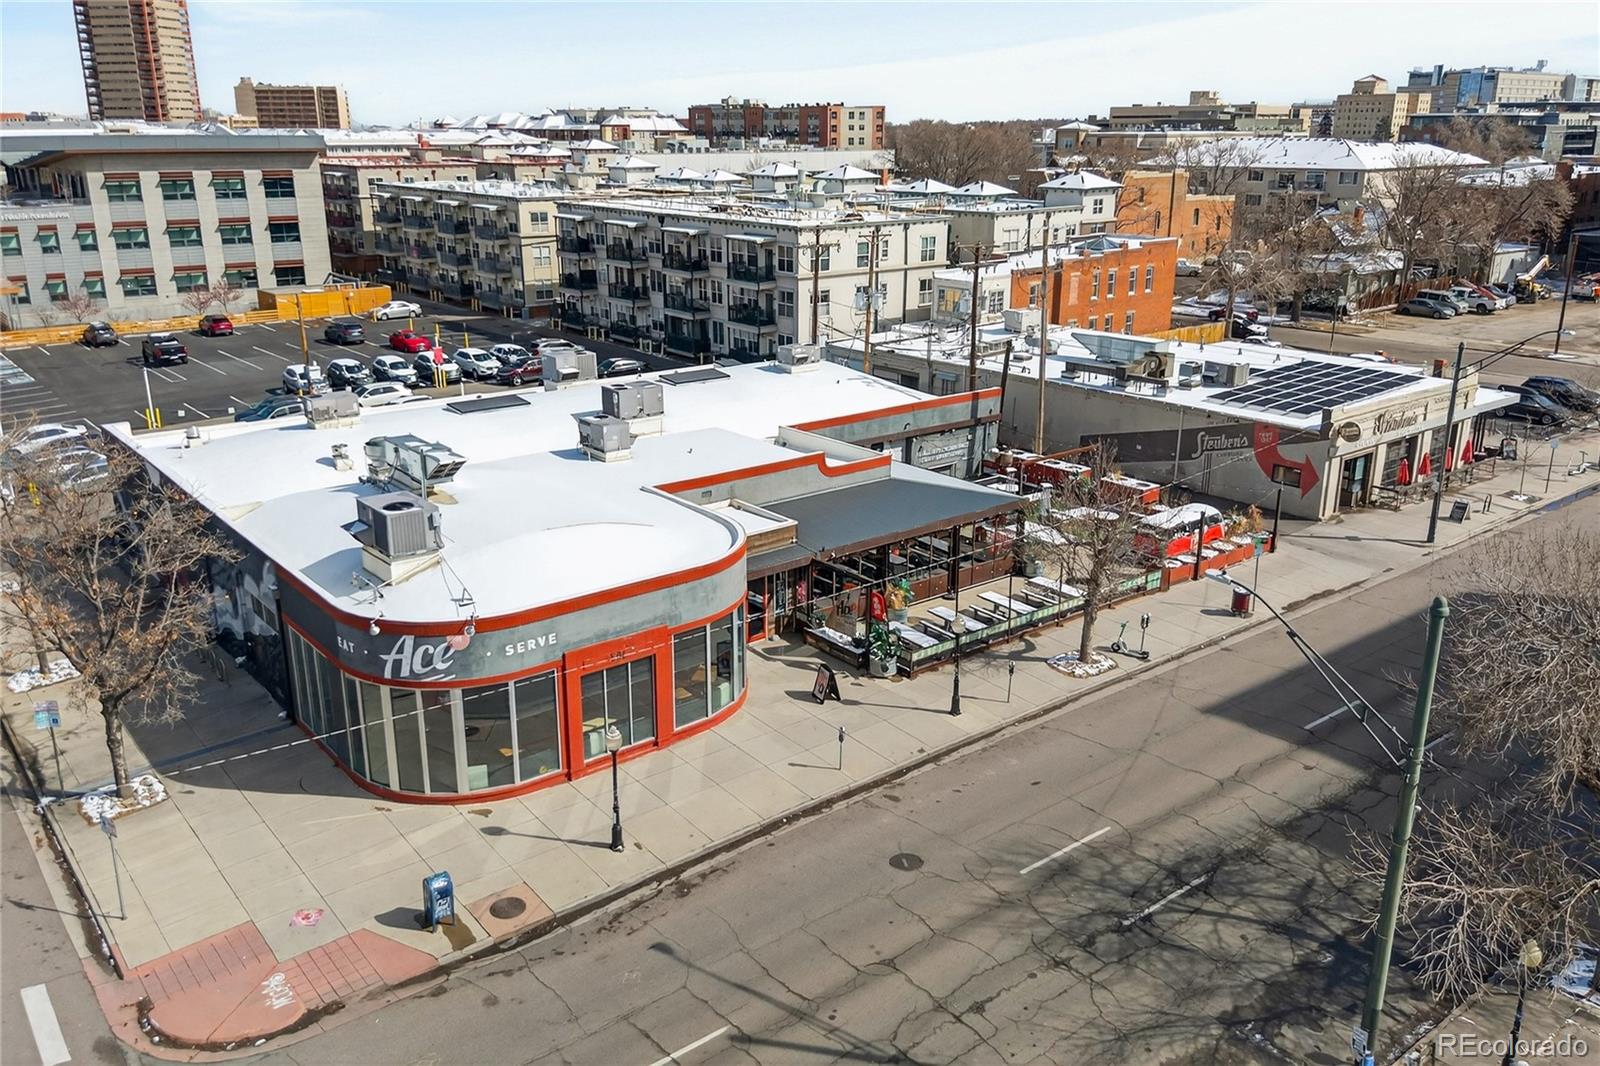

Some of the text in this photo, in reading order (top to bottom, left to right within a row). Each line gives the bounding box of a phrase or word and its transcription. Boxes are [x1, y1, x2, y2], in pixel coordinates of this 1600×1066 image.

[1191, 431, 1249, 459] Steuben's
[336, 632, 558, 679] EAT Ace SERVE
